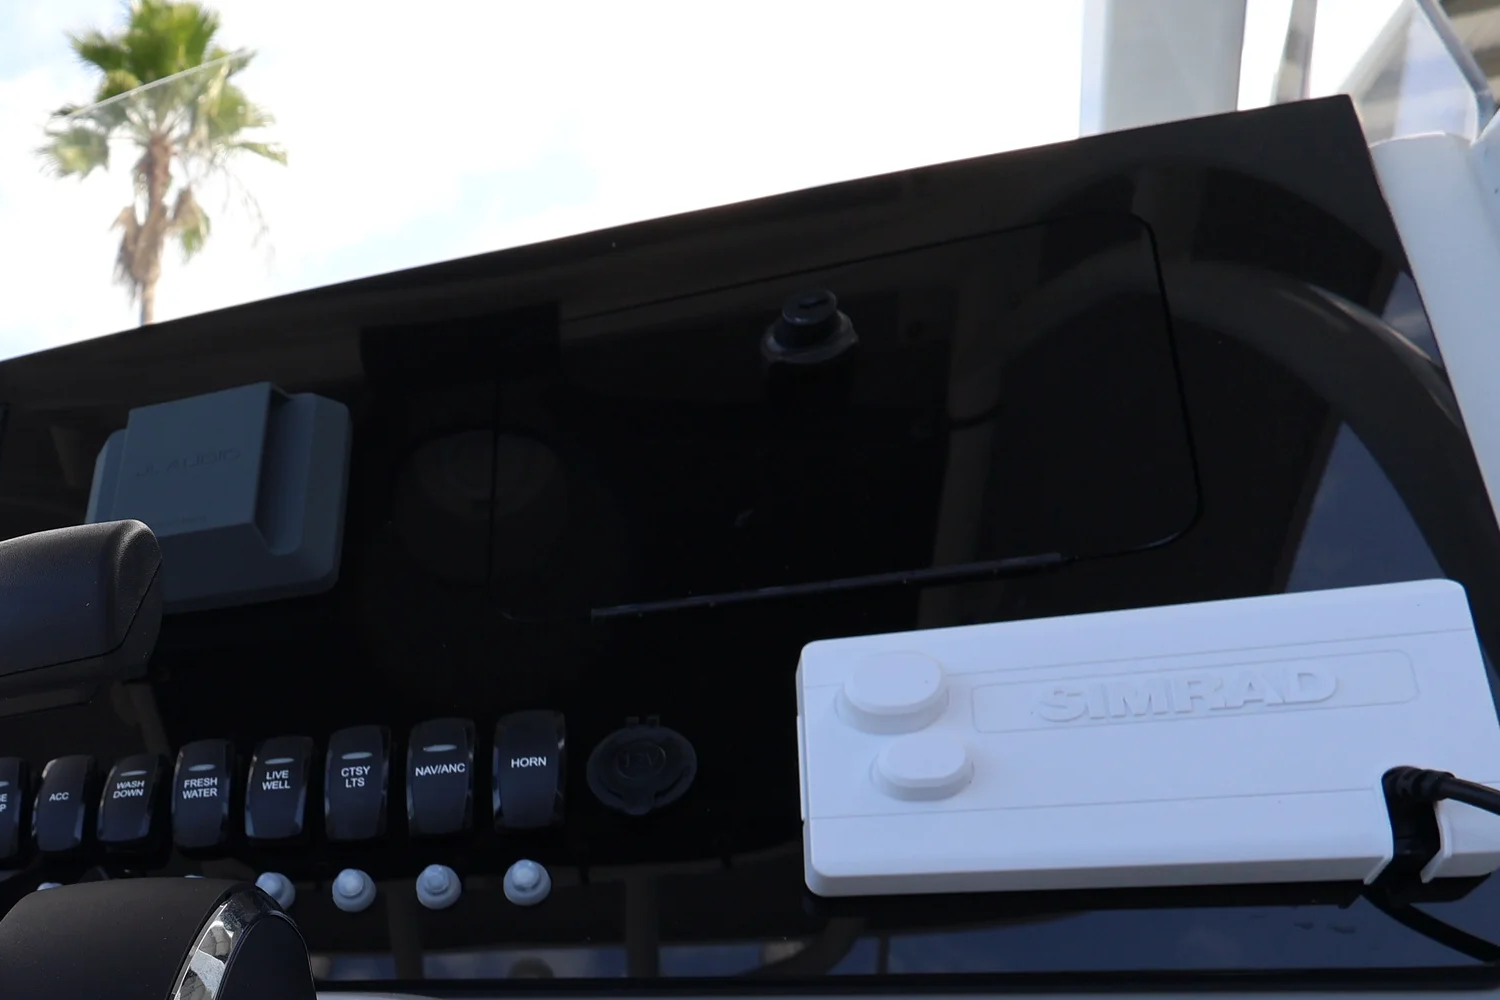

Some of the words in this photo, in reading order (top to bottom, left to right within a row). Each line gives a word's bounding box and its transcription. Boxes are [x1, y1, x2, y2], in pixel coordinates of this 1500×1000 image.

[1039, 664, 1338, 722] SIMRAD
[511, 756, 547, 768] HORN
[266, 770, 289, 780] LIVE
[341, 766, 370, 778] CTSY
[415, 763, 465, 776] NAV/ANC
[116, 780, 145, 789] WASH
[183, 777, 218, 788] FRESH
[262, 779, 291, 790] WELL
[345, 776, 365, 788] LTS
[49, 792, 69, 801] ACC
[113, 788, 143, 798] DOWN
[182, 787, 218, 799] WATER
